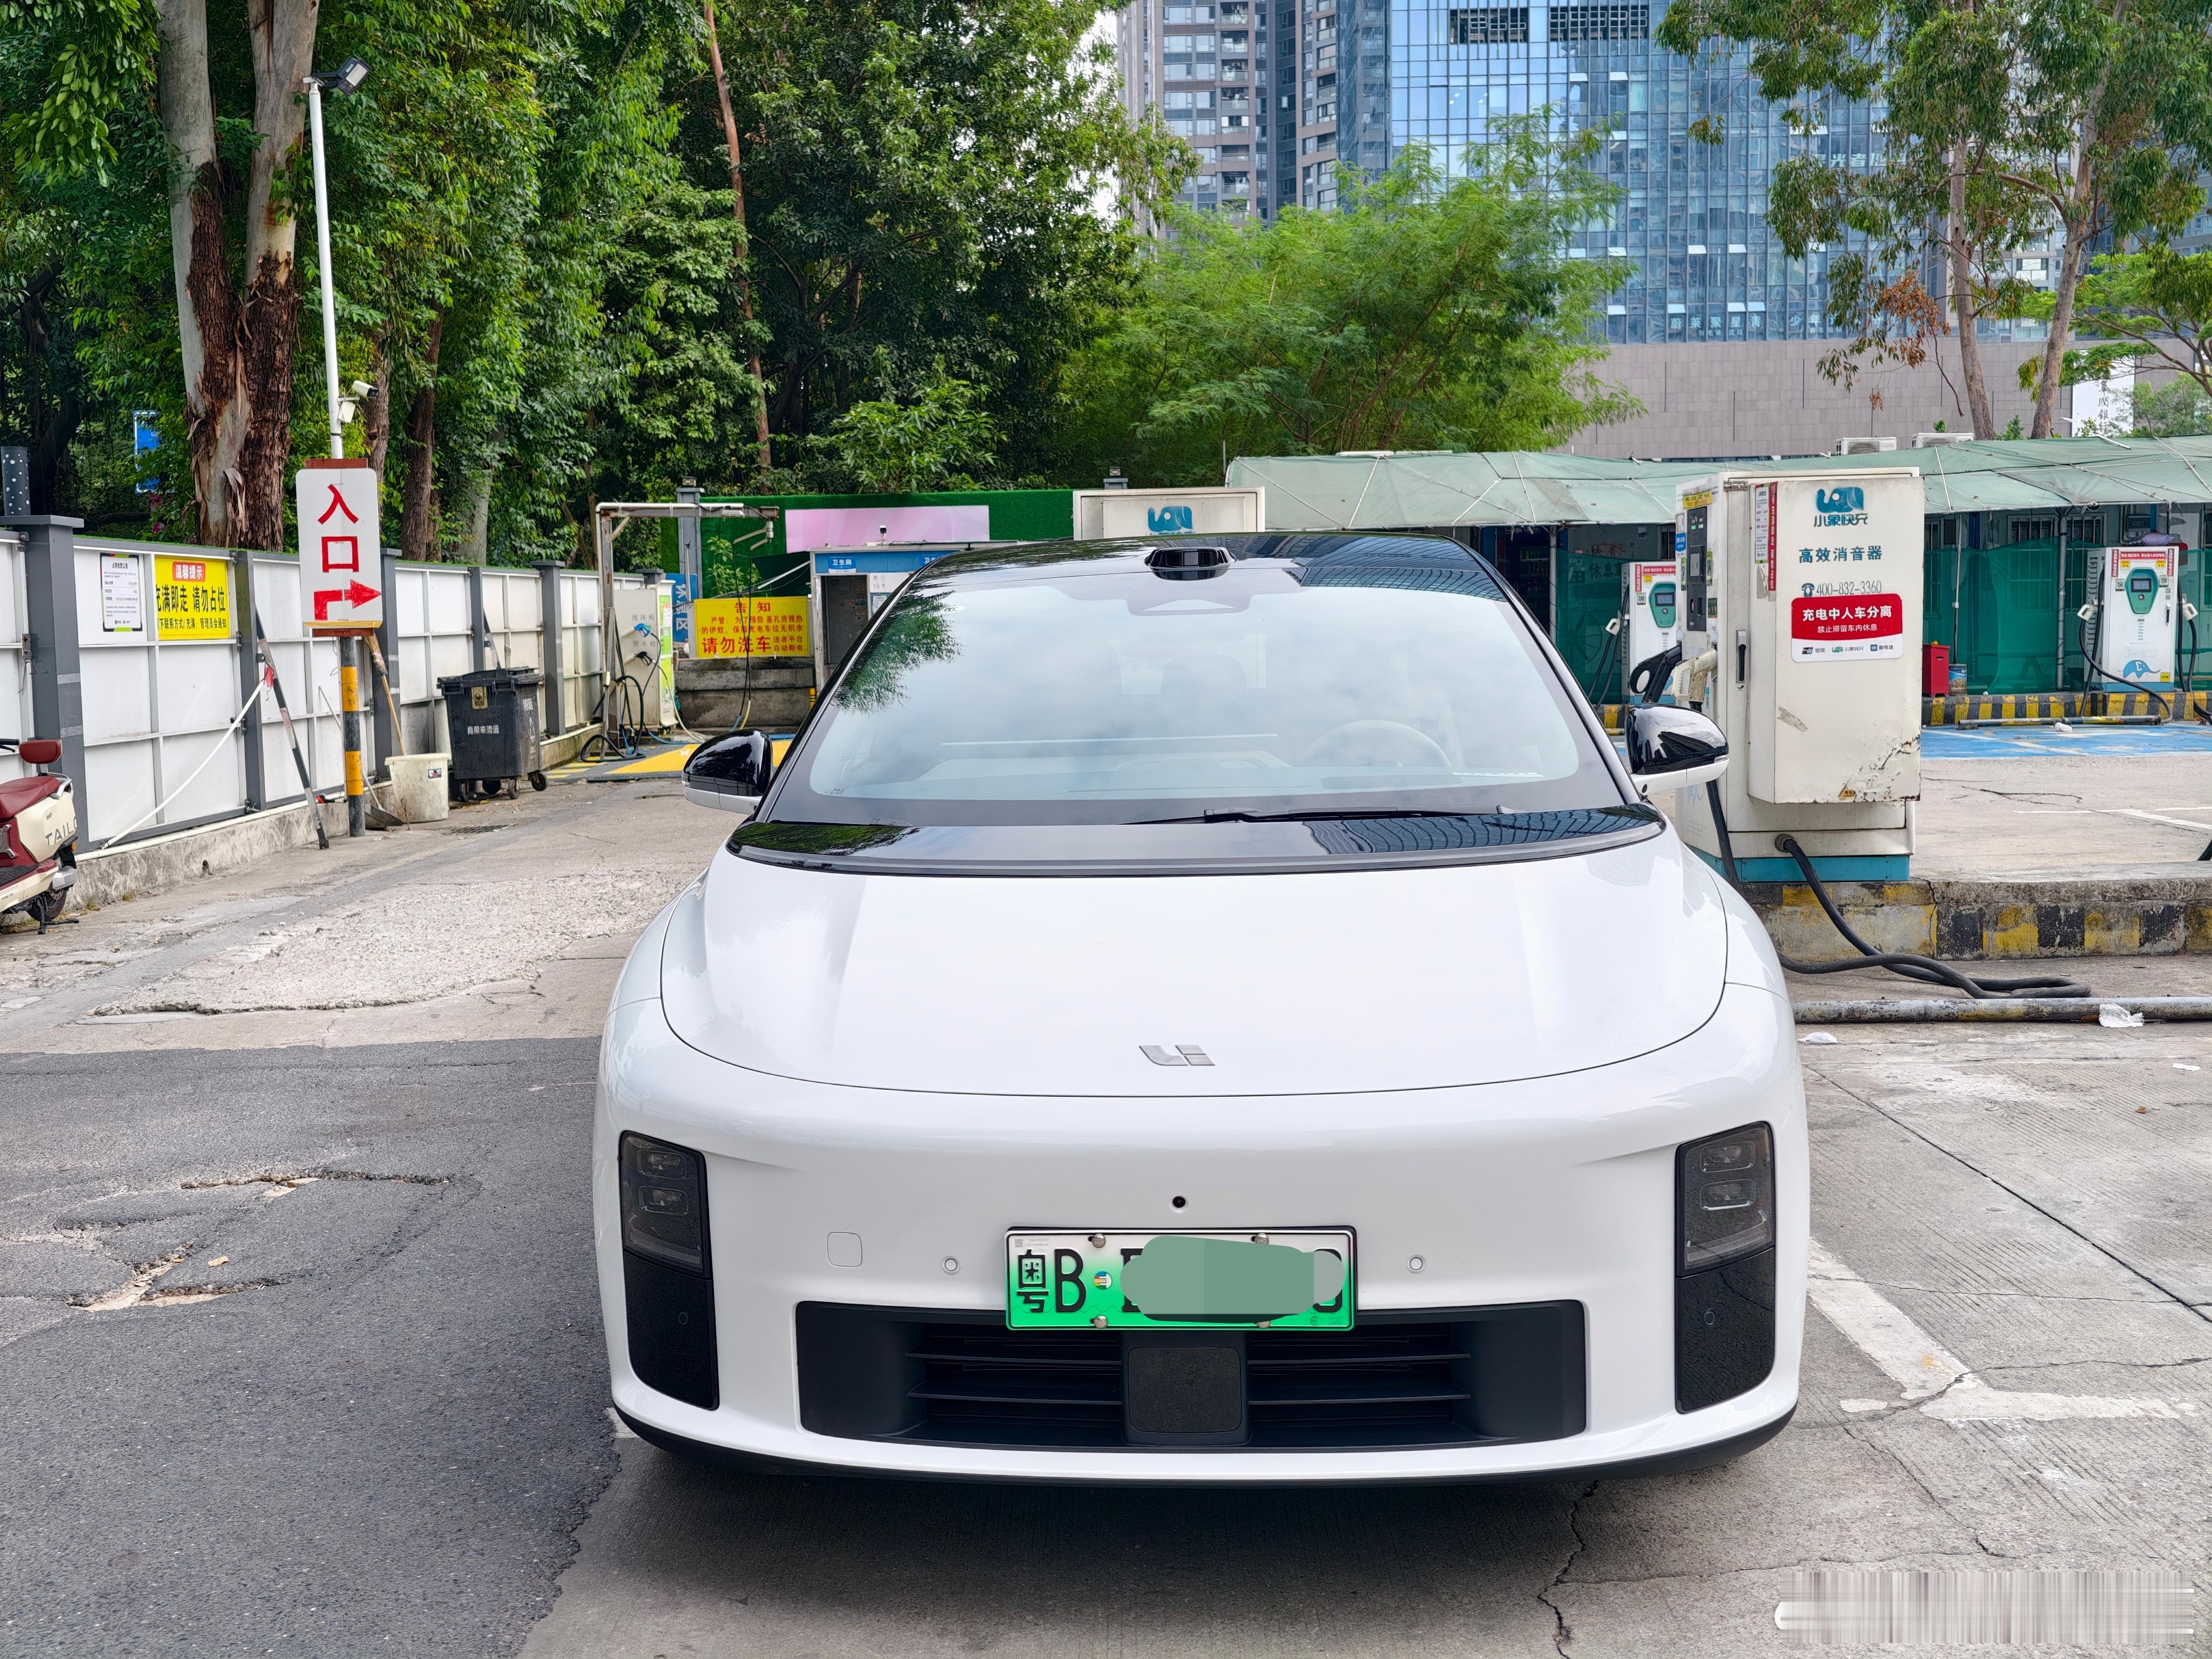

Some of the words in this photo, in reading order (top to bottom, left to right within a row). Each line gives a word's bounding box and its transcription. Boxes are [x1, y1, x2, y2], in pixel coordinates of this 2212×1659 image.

[1813, 513, 1869, 527] 小象快充
[318, 484, 359, 573] 入口
[1798, 545, 1883, 563] 高效消音器
[176, 564, 203, 579] 温馨提示
[1816, 581, 1883, 596] 400-832-3360
[192, 585, 226, 613] 请勿占位
[734, 602, 771, 613] 告知
[1802, 605, 1892, 622] 充电中人车分离
[1817, 623, 1878, 633] 禁止滞留车内休息
[702, 636, 771, 654] 请勿洗车
